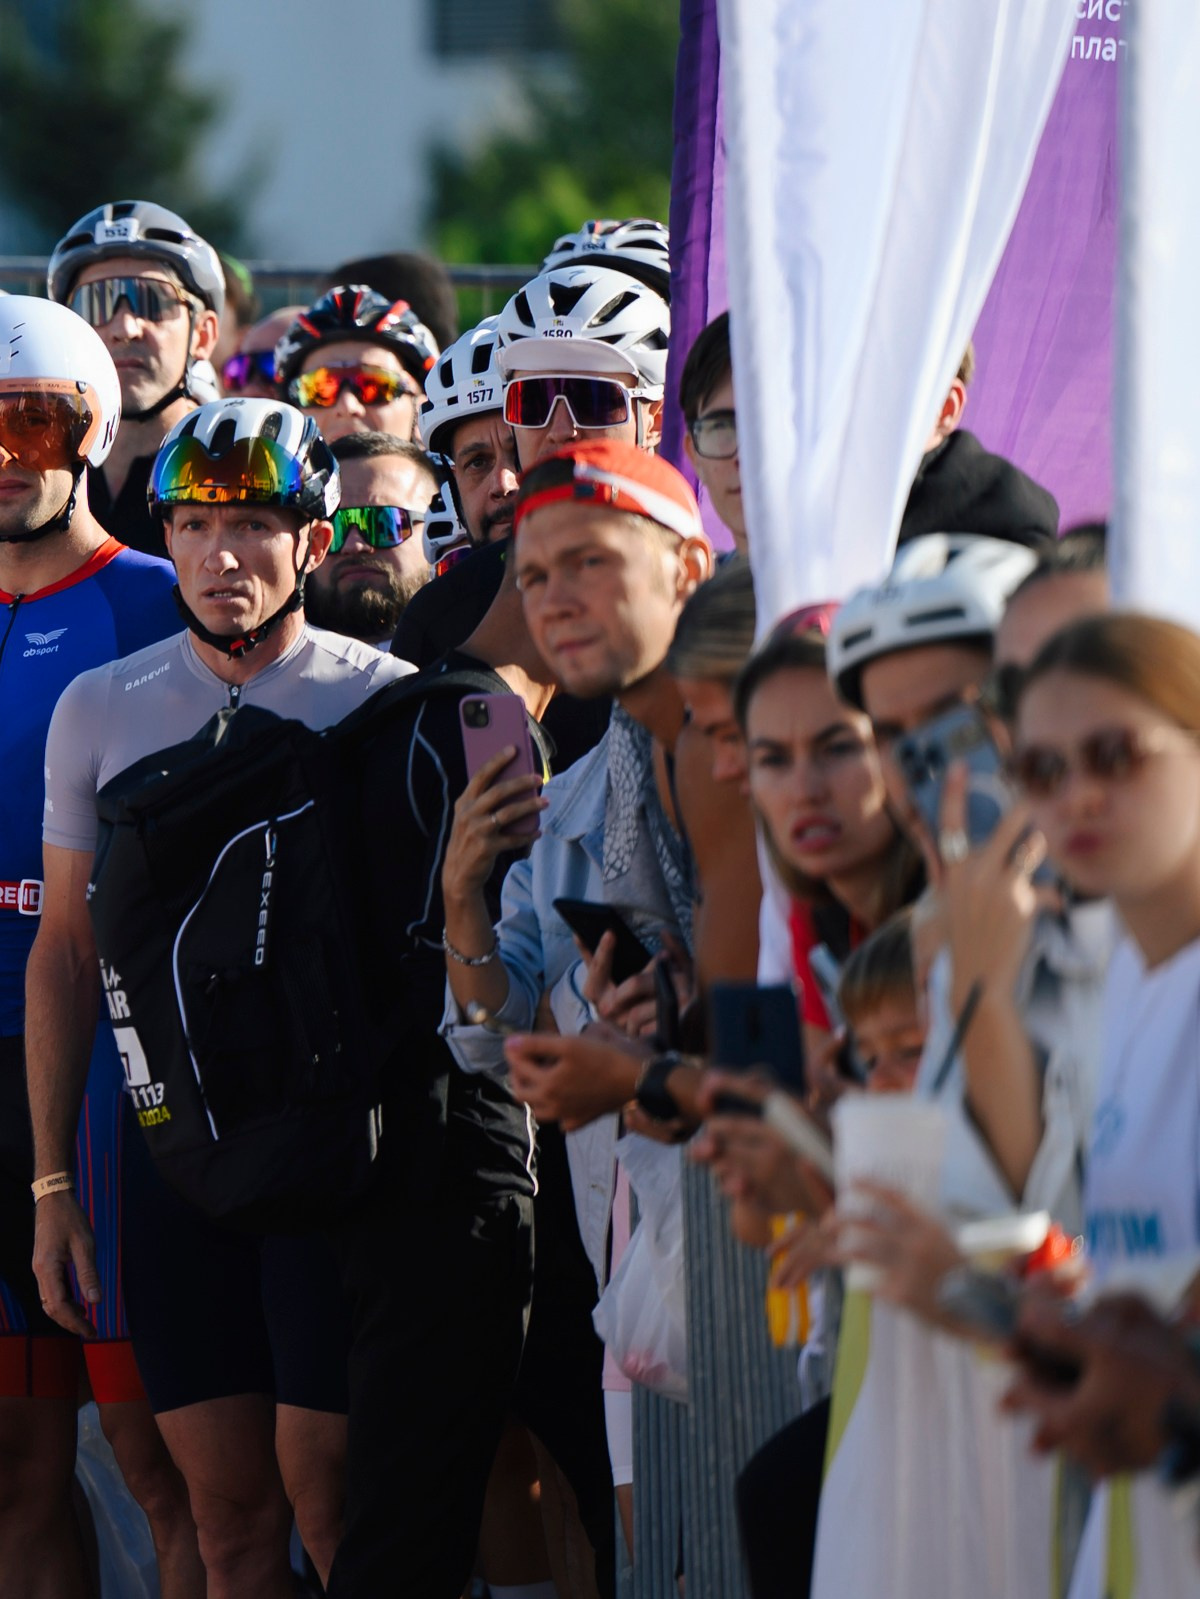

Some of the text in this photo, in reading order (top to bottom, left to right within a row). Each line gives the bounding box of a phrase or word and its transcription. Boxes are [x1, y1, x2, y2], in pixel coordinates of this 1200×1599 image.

[467, 388, 493, 404] 1577
[125, 662, 170, 691] DAREVIE
[255, 871, 272, 965] EXEED
[139, 1082, 164, 1107] 113
